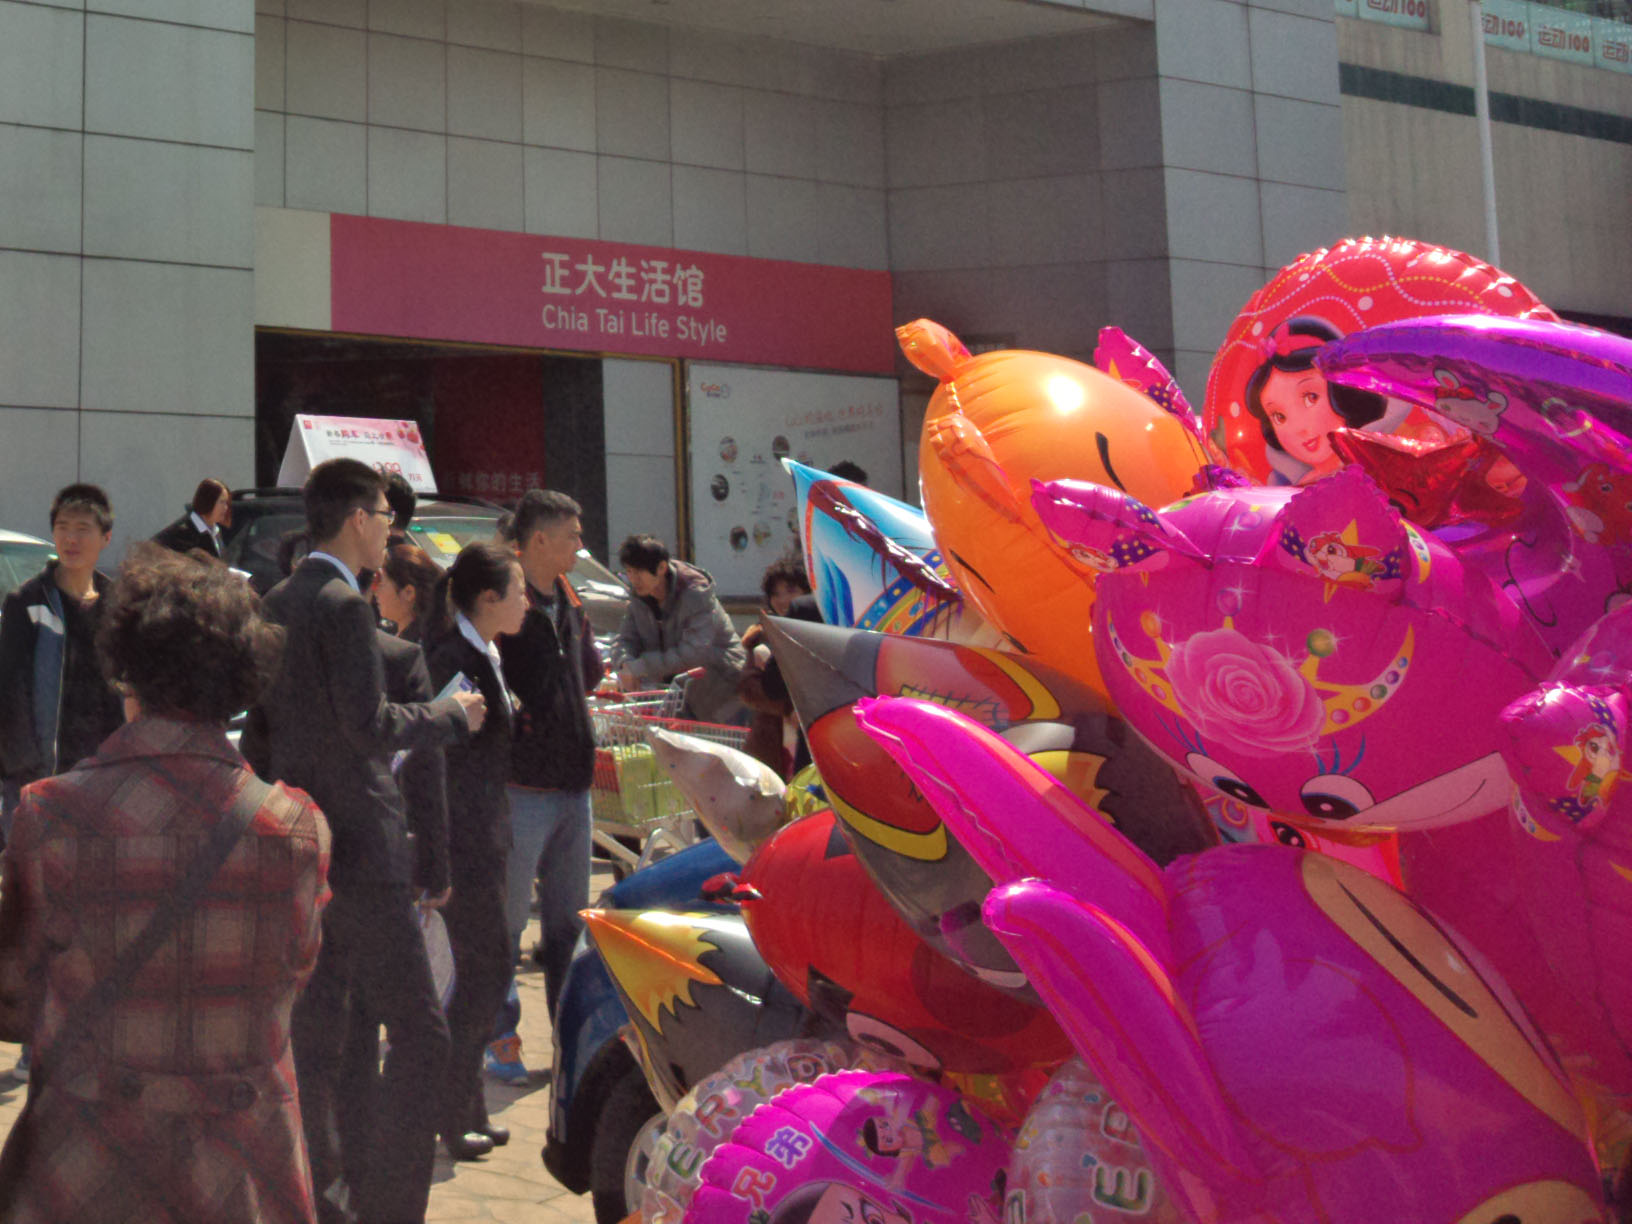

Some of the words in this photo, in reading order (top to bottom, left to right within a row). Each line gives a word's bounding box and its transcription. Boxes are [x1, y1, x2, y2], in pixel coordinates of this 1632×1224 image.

[1482, 12, 1526, 40] 动100
[541, 251, 705, 308] 正大生活馆
[542, 303, 588, 332] Chia
[595, 308, 625, 334] Tai
[631, 311, 670, 338] Life
[676, 315, 728, 347] Style
